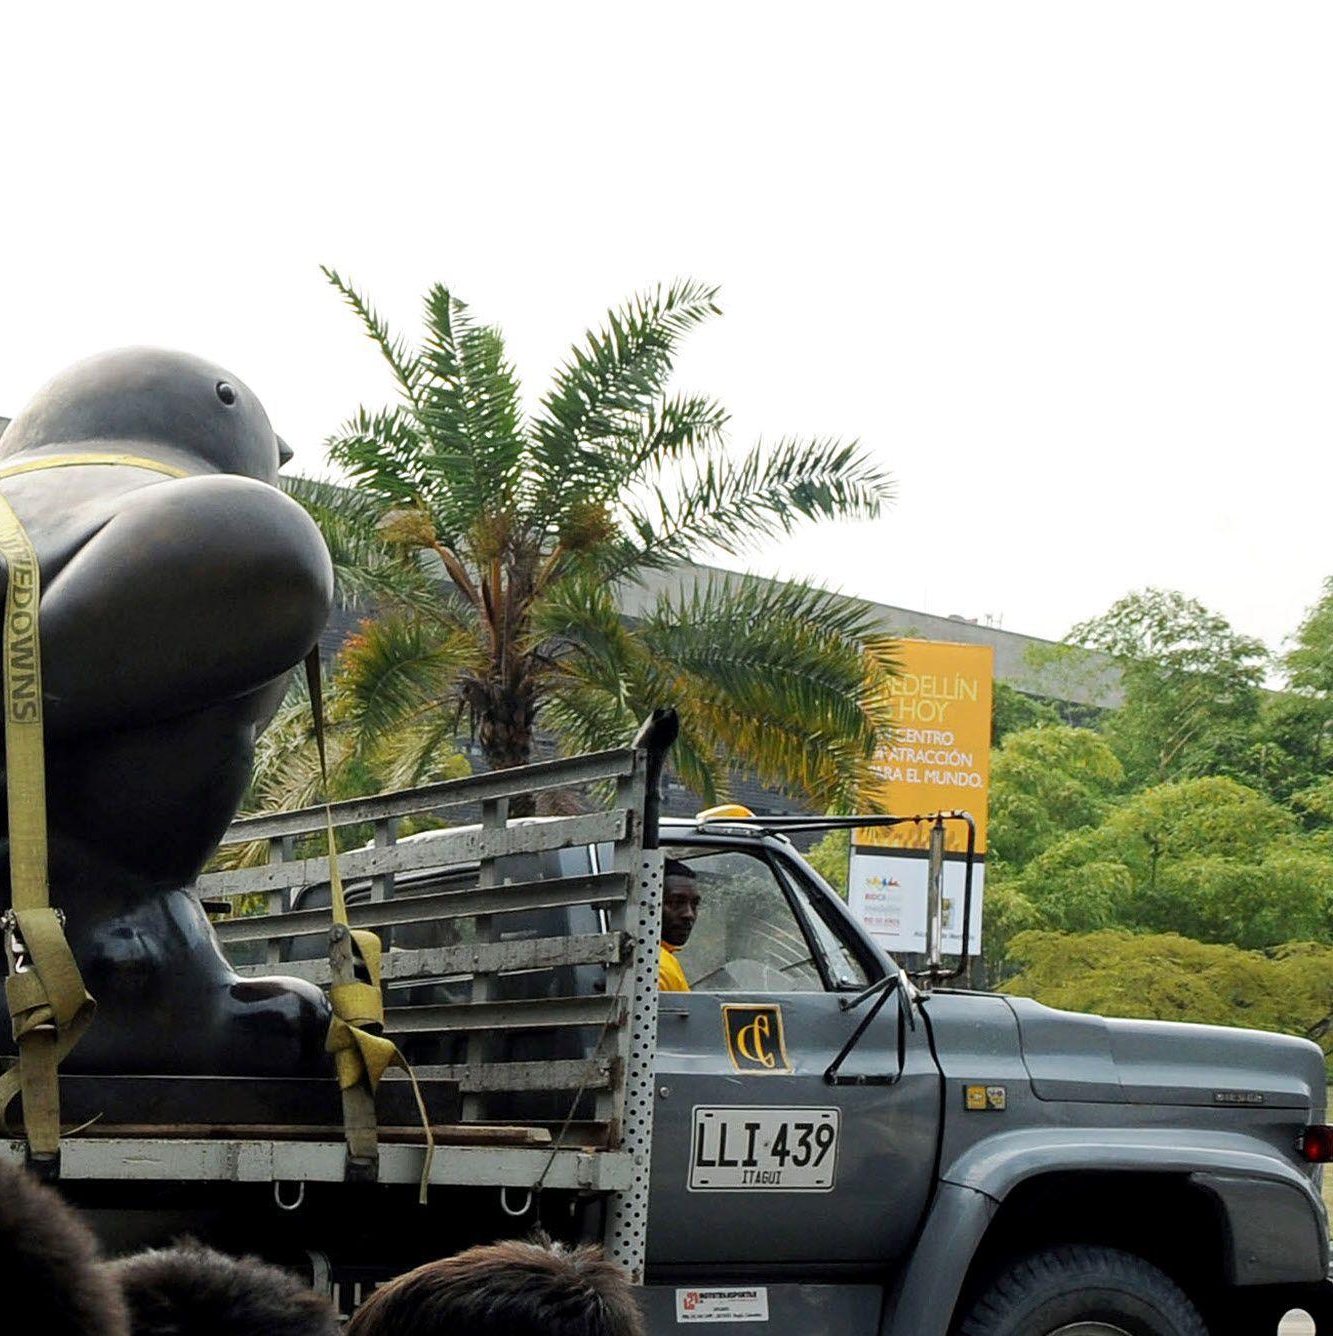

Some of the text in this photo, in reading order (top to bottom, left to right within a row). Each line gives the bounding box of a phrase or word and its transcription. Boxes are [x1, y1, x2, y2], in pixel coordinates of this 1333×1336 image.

[898, 700, 949, 722] HOY
[895, 728, 955, 746] CENTRO
[887, 747, 974, 767] ATRACCIÓN
[906, 768, 921, 783] EL
[924, 769, 984, 788] MUNDO.
[696, 1123, 835, 1167] LLI 439
[741, 1170, 782, 1184] ITAGUI
